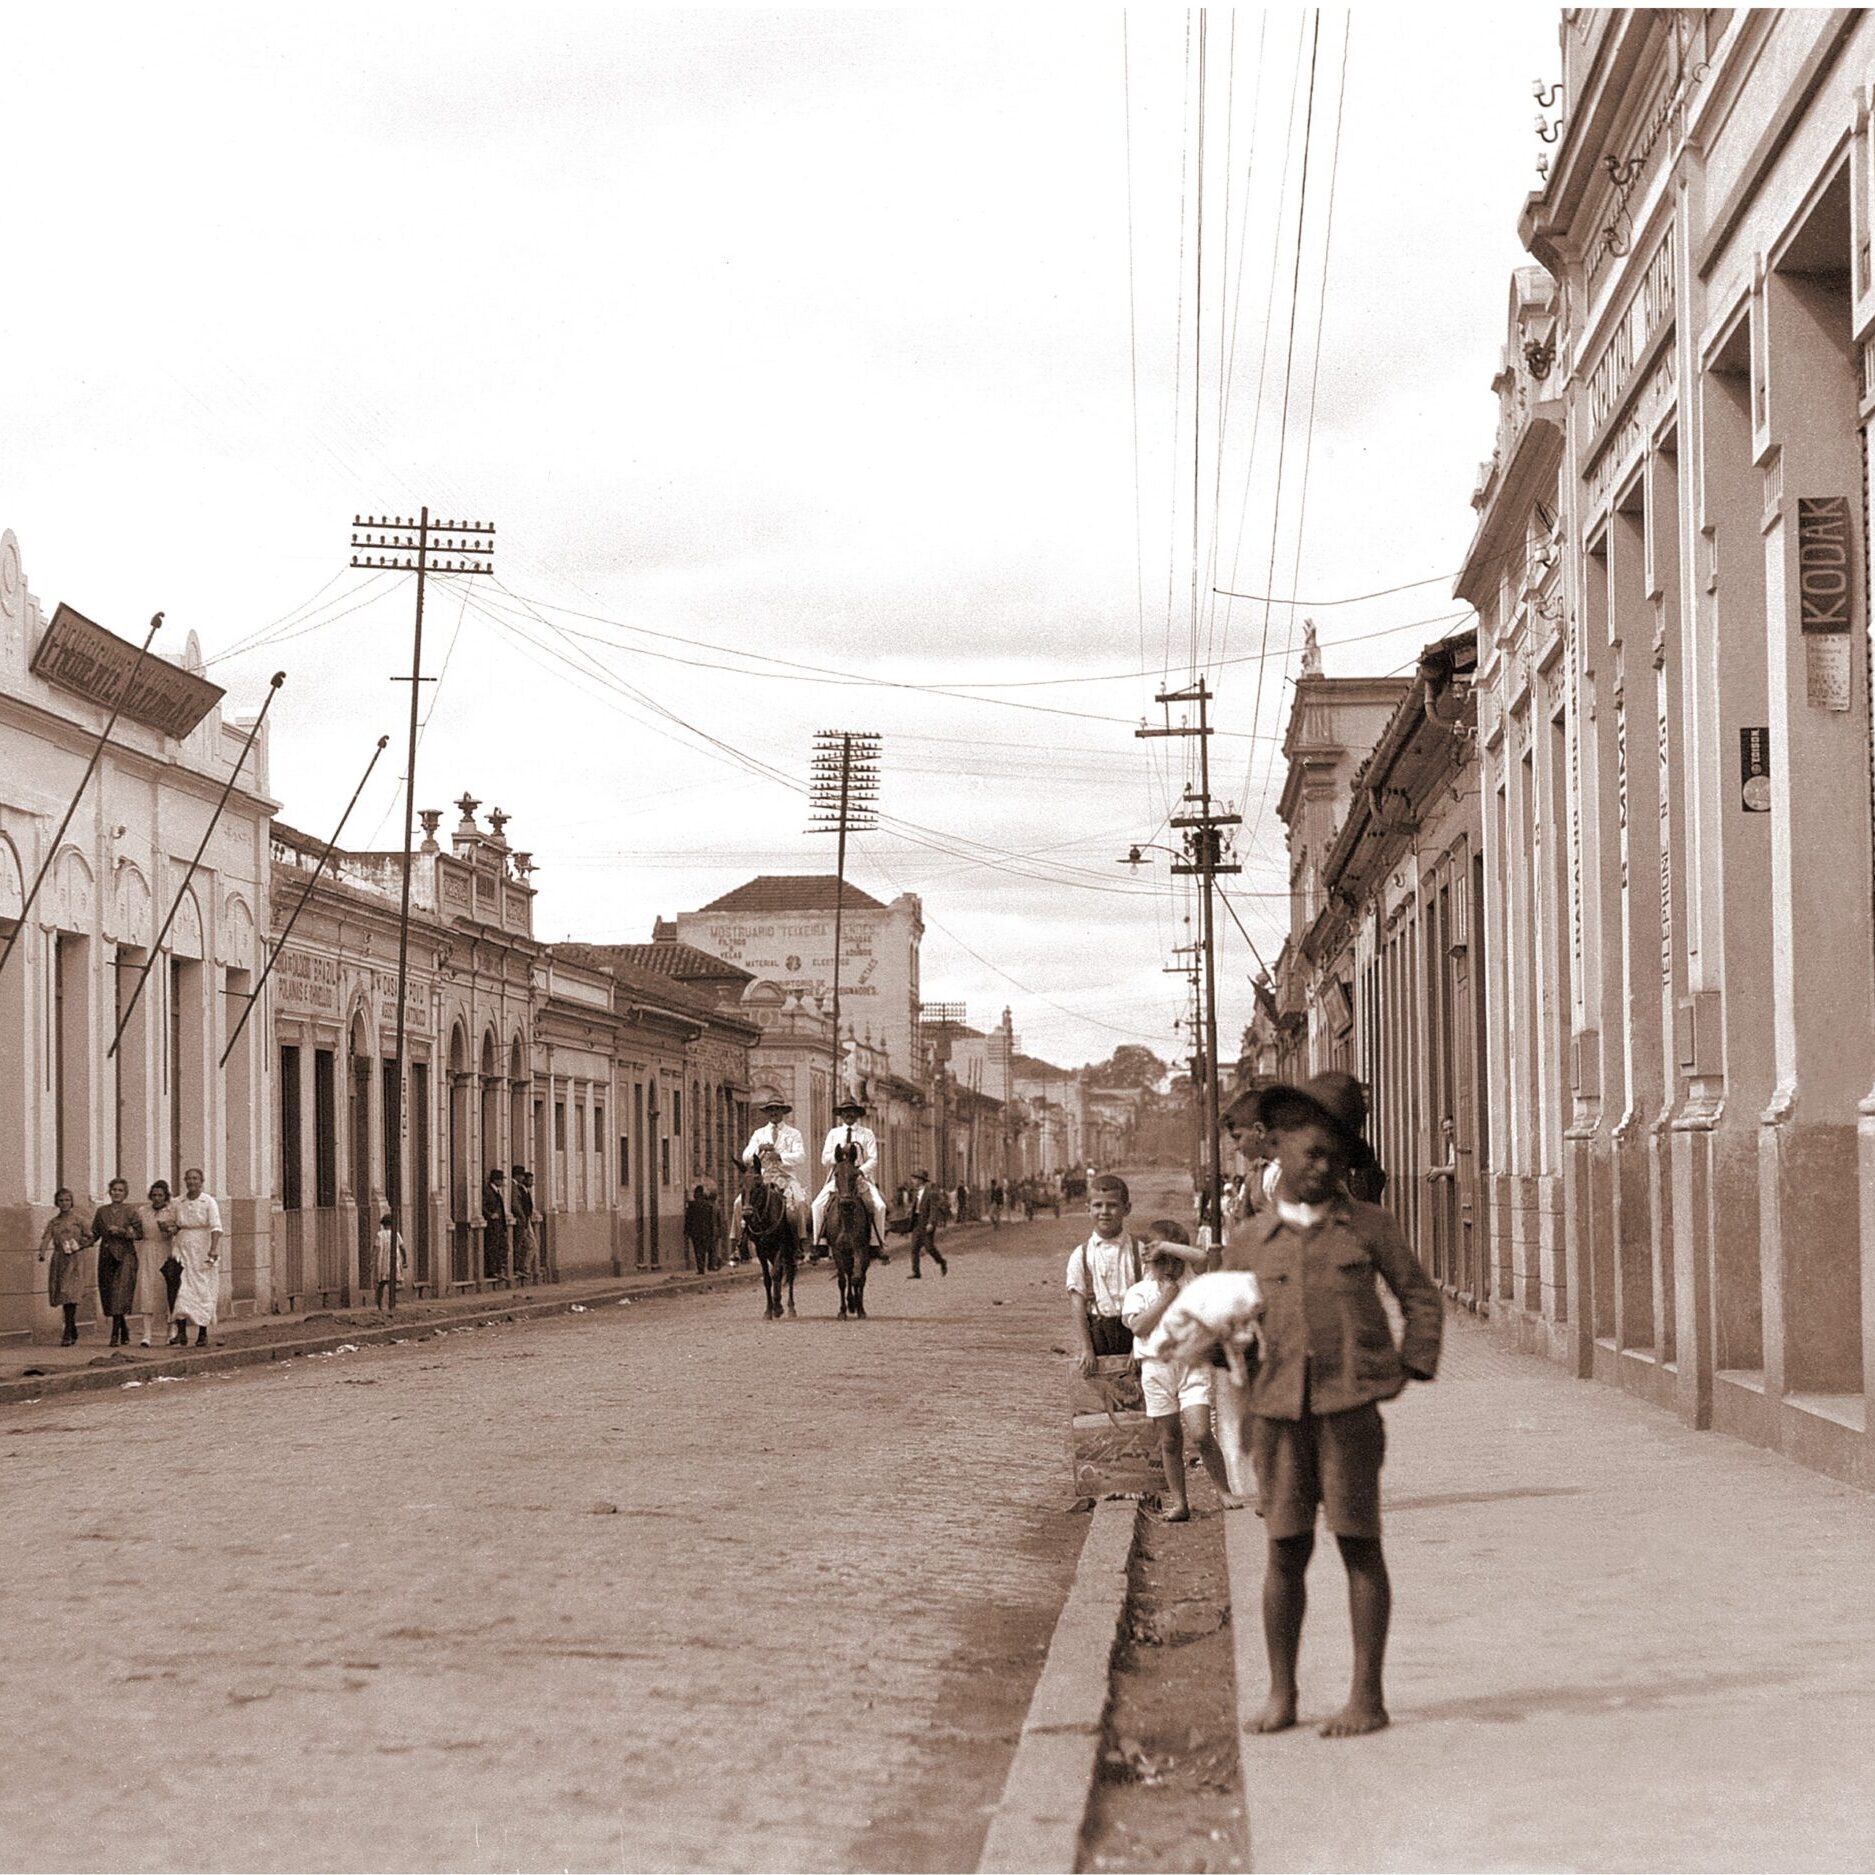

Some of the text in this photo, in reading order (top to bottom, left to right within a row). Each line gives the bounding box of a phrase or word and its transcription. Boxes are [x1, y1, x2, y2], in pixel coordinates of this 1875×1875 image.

[1799, 498, 1848, 623] KODAK
[711, 925, 774, 938] MOSTRUARIO
[745, 959, 779, 967] MATERIAL
